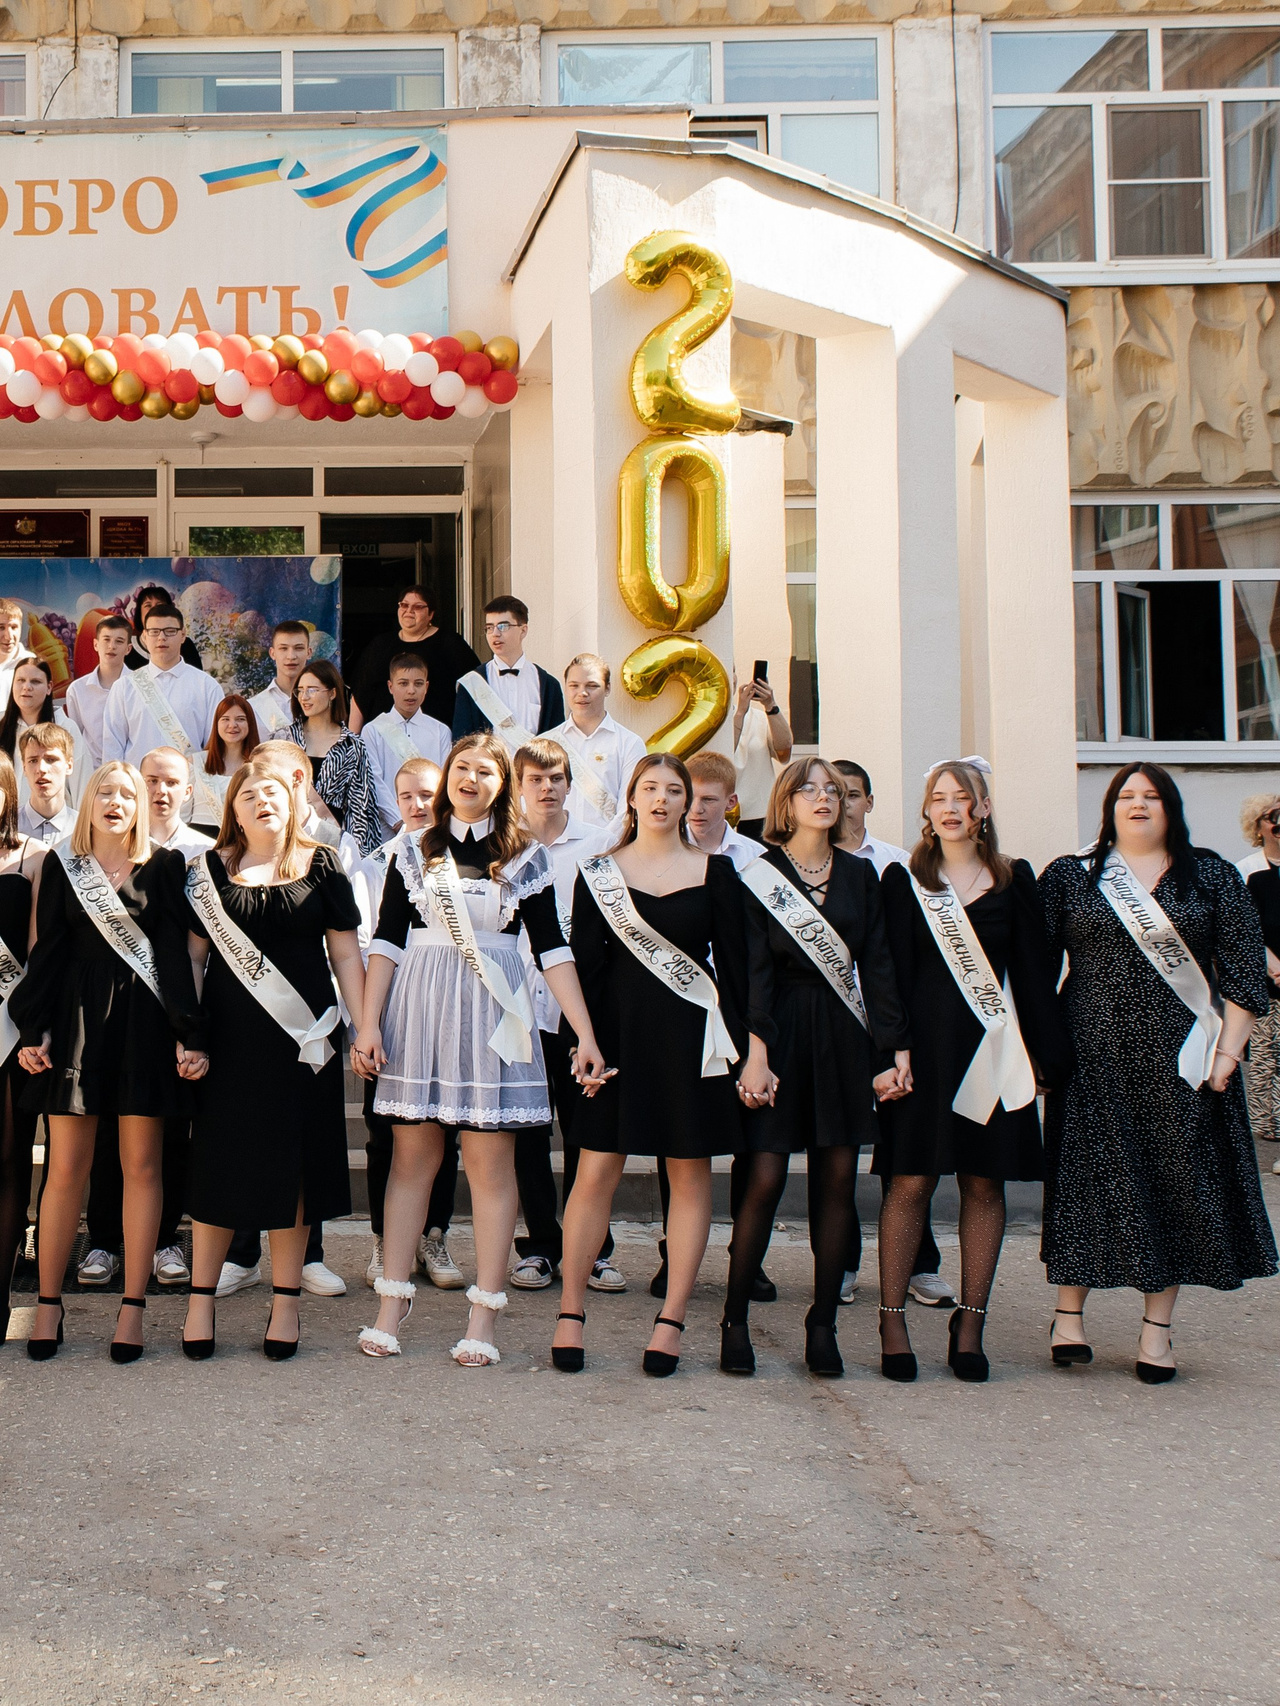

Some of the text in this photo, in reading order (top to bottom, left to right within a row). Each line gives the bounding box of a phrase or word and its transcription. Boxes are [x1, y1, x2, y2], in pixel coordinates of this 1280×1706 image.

[343, 544, 377, 555] ВХОД
[76, 876, 147, 963] Выпускница
[186, 871, 243, 958] Выпускница
[592, 876, 701, 986] Выпускник 2025
[786, 910, 858, 1003] Выпускник
[918, 886, 1007, 1017] Выпускник 2025
[1100, 856, 1191, 968] Выпускник 2025
[460, 947, 484, 979] 202
